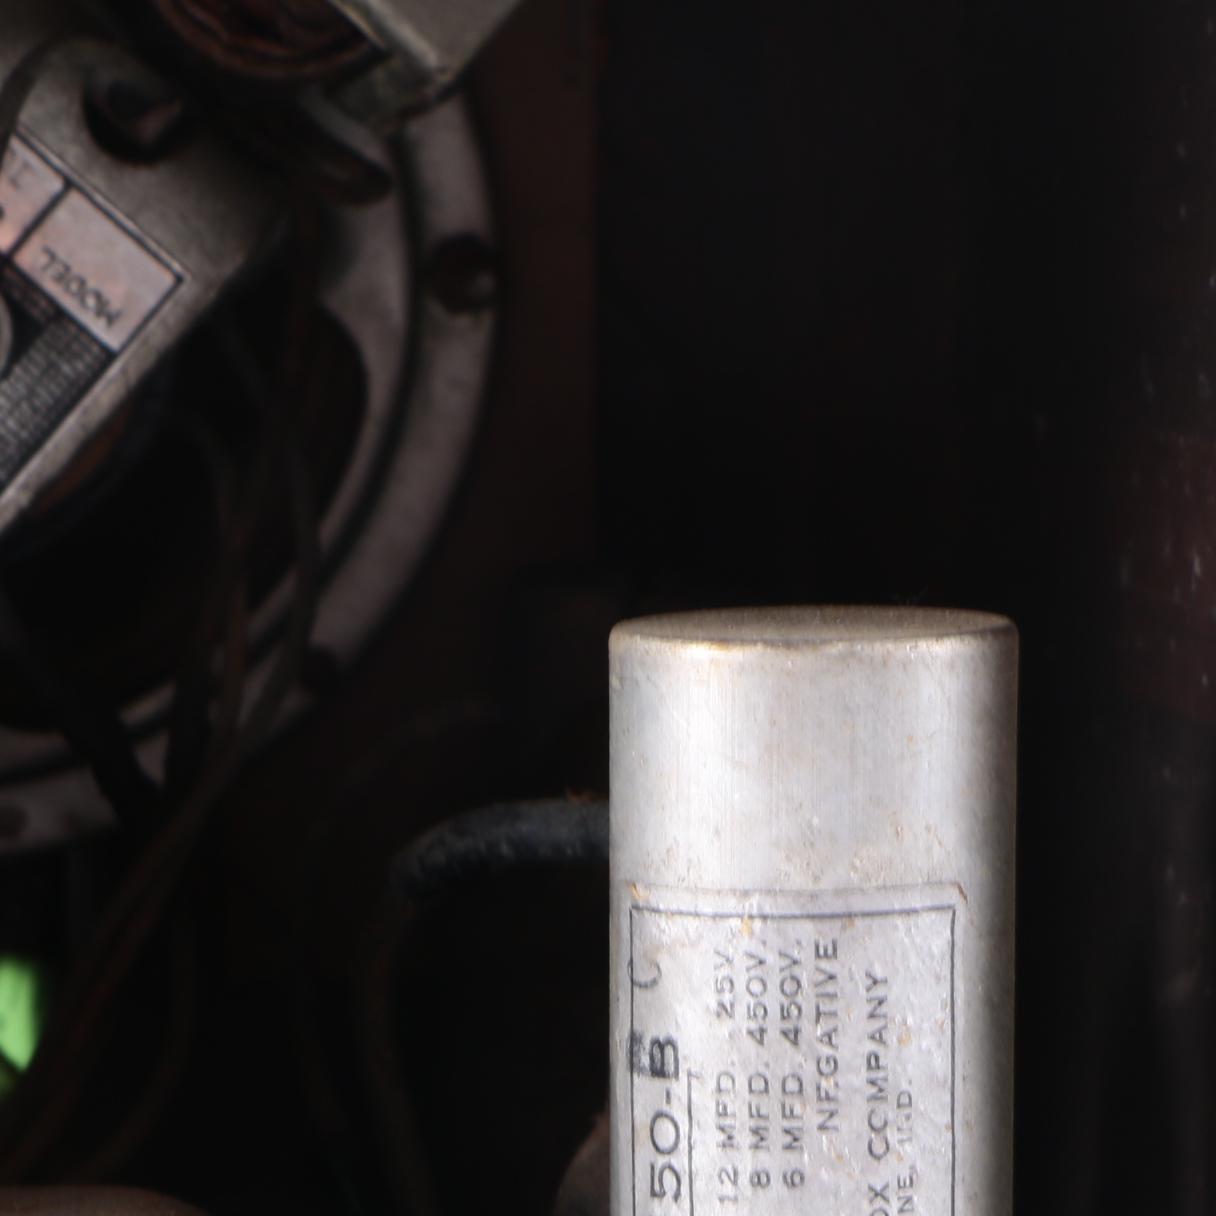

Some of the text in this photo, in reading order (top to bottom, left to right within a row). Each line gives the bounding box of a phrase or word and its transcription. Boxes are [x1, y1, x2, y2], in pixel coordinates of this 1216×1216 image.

[41, 246, 121, 327] MODEL
[717, 1165, 739, 1204] 12
[749, 1168, 771, 1188] 8
[783, 1167, 805, 1189] 6
